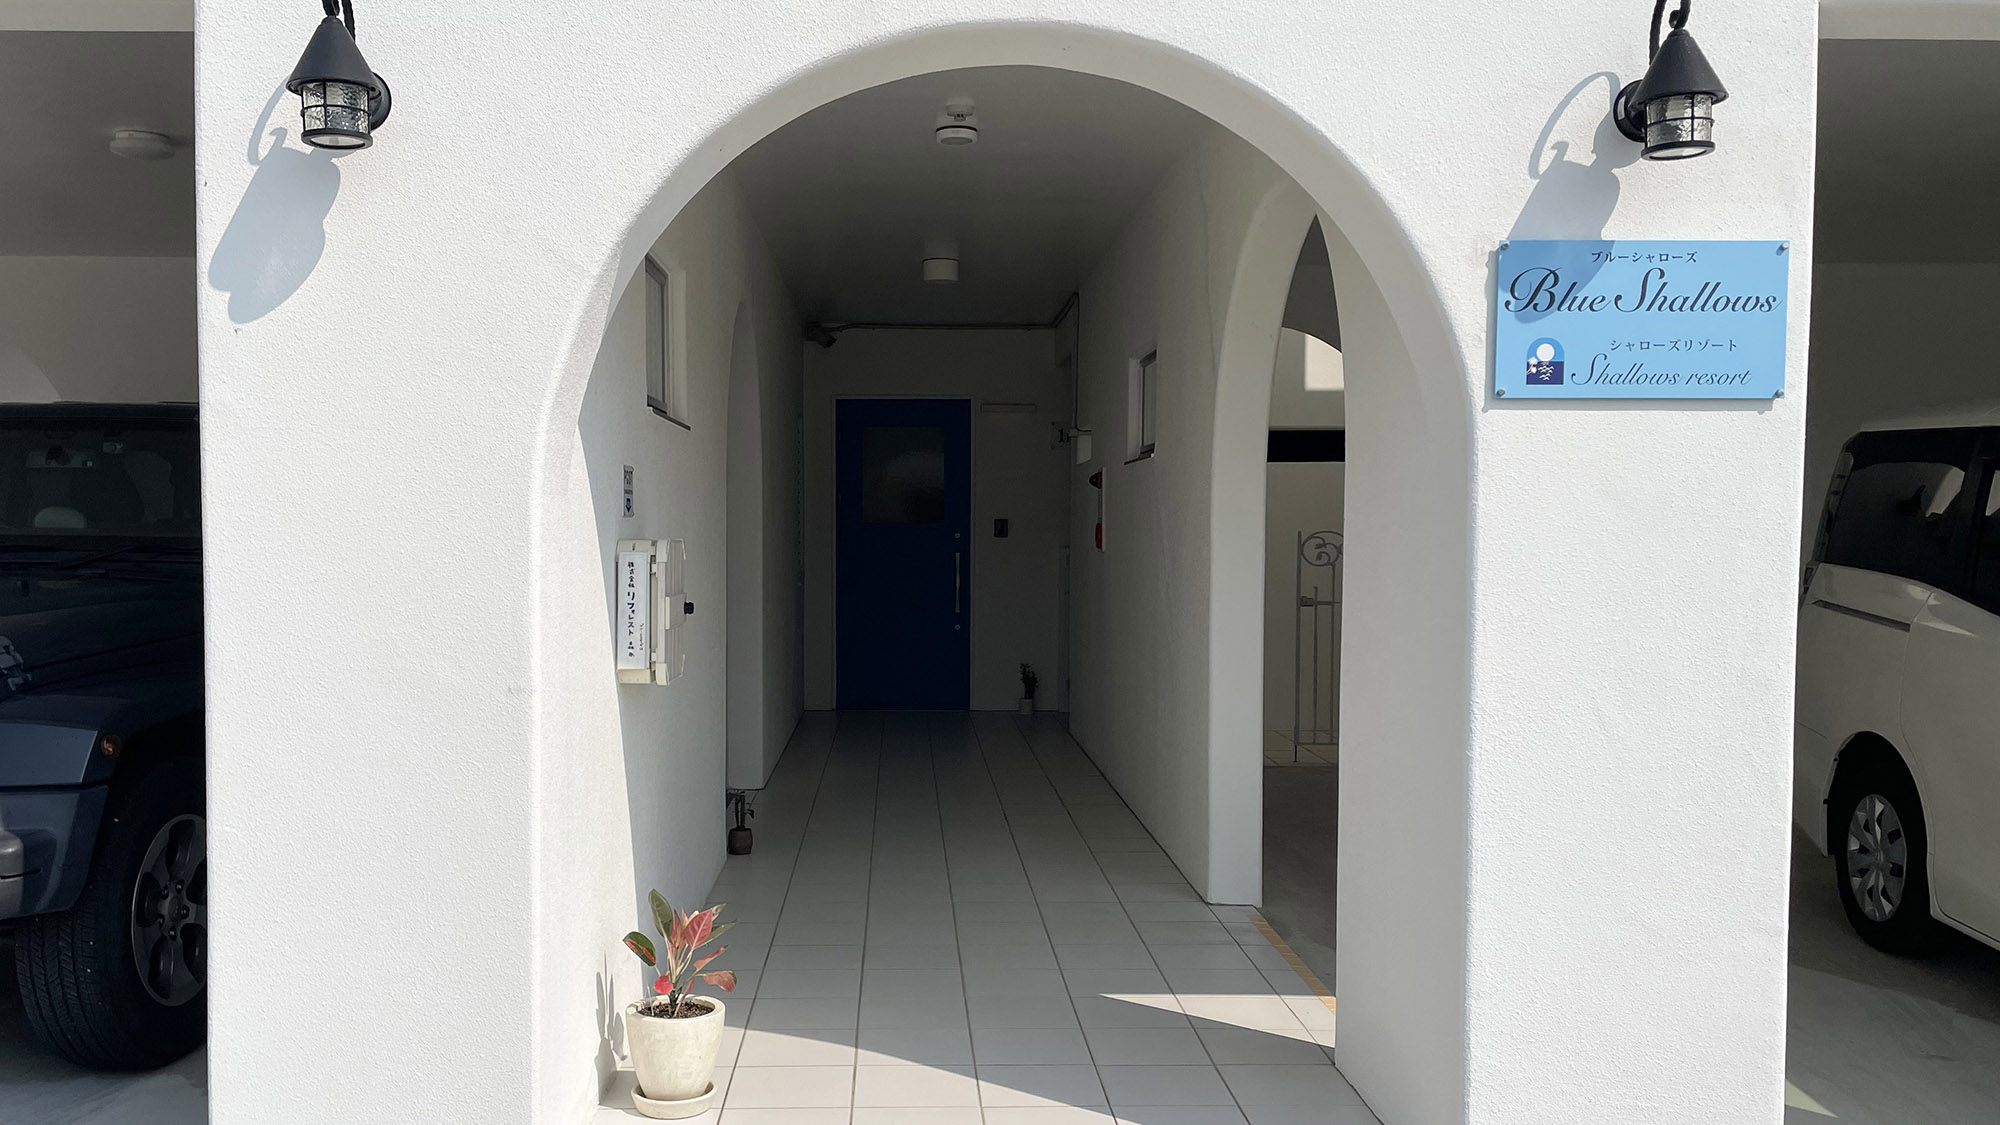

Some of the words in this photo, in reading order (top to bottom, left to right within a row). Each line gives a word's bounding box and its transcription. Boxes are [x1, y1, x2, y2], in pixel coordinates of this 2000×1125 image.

[1591, 251, 1698, 264] ブルーシャローズ
[1504, 267, 1611, 313] Blue
[1614, 267, 1781, 313] Shallows
[1609, 339, 1738, 352] シャローズリゾート
[1570, 353, 1681, 386] Shallows
[1685, 368, 1752, 386] resort
